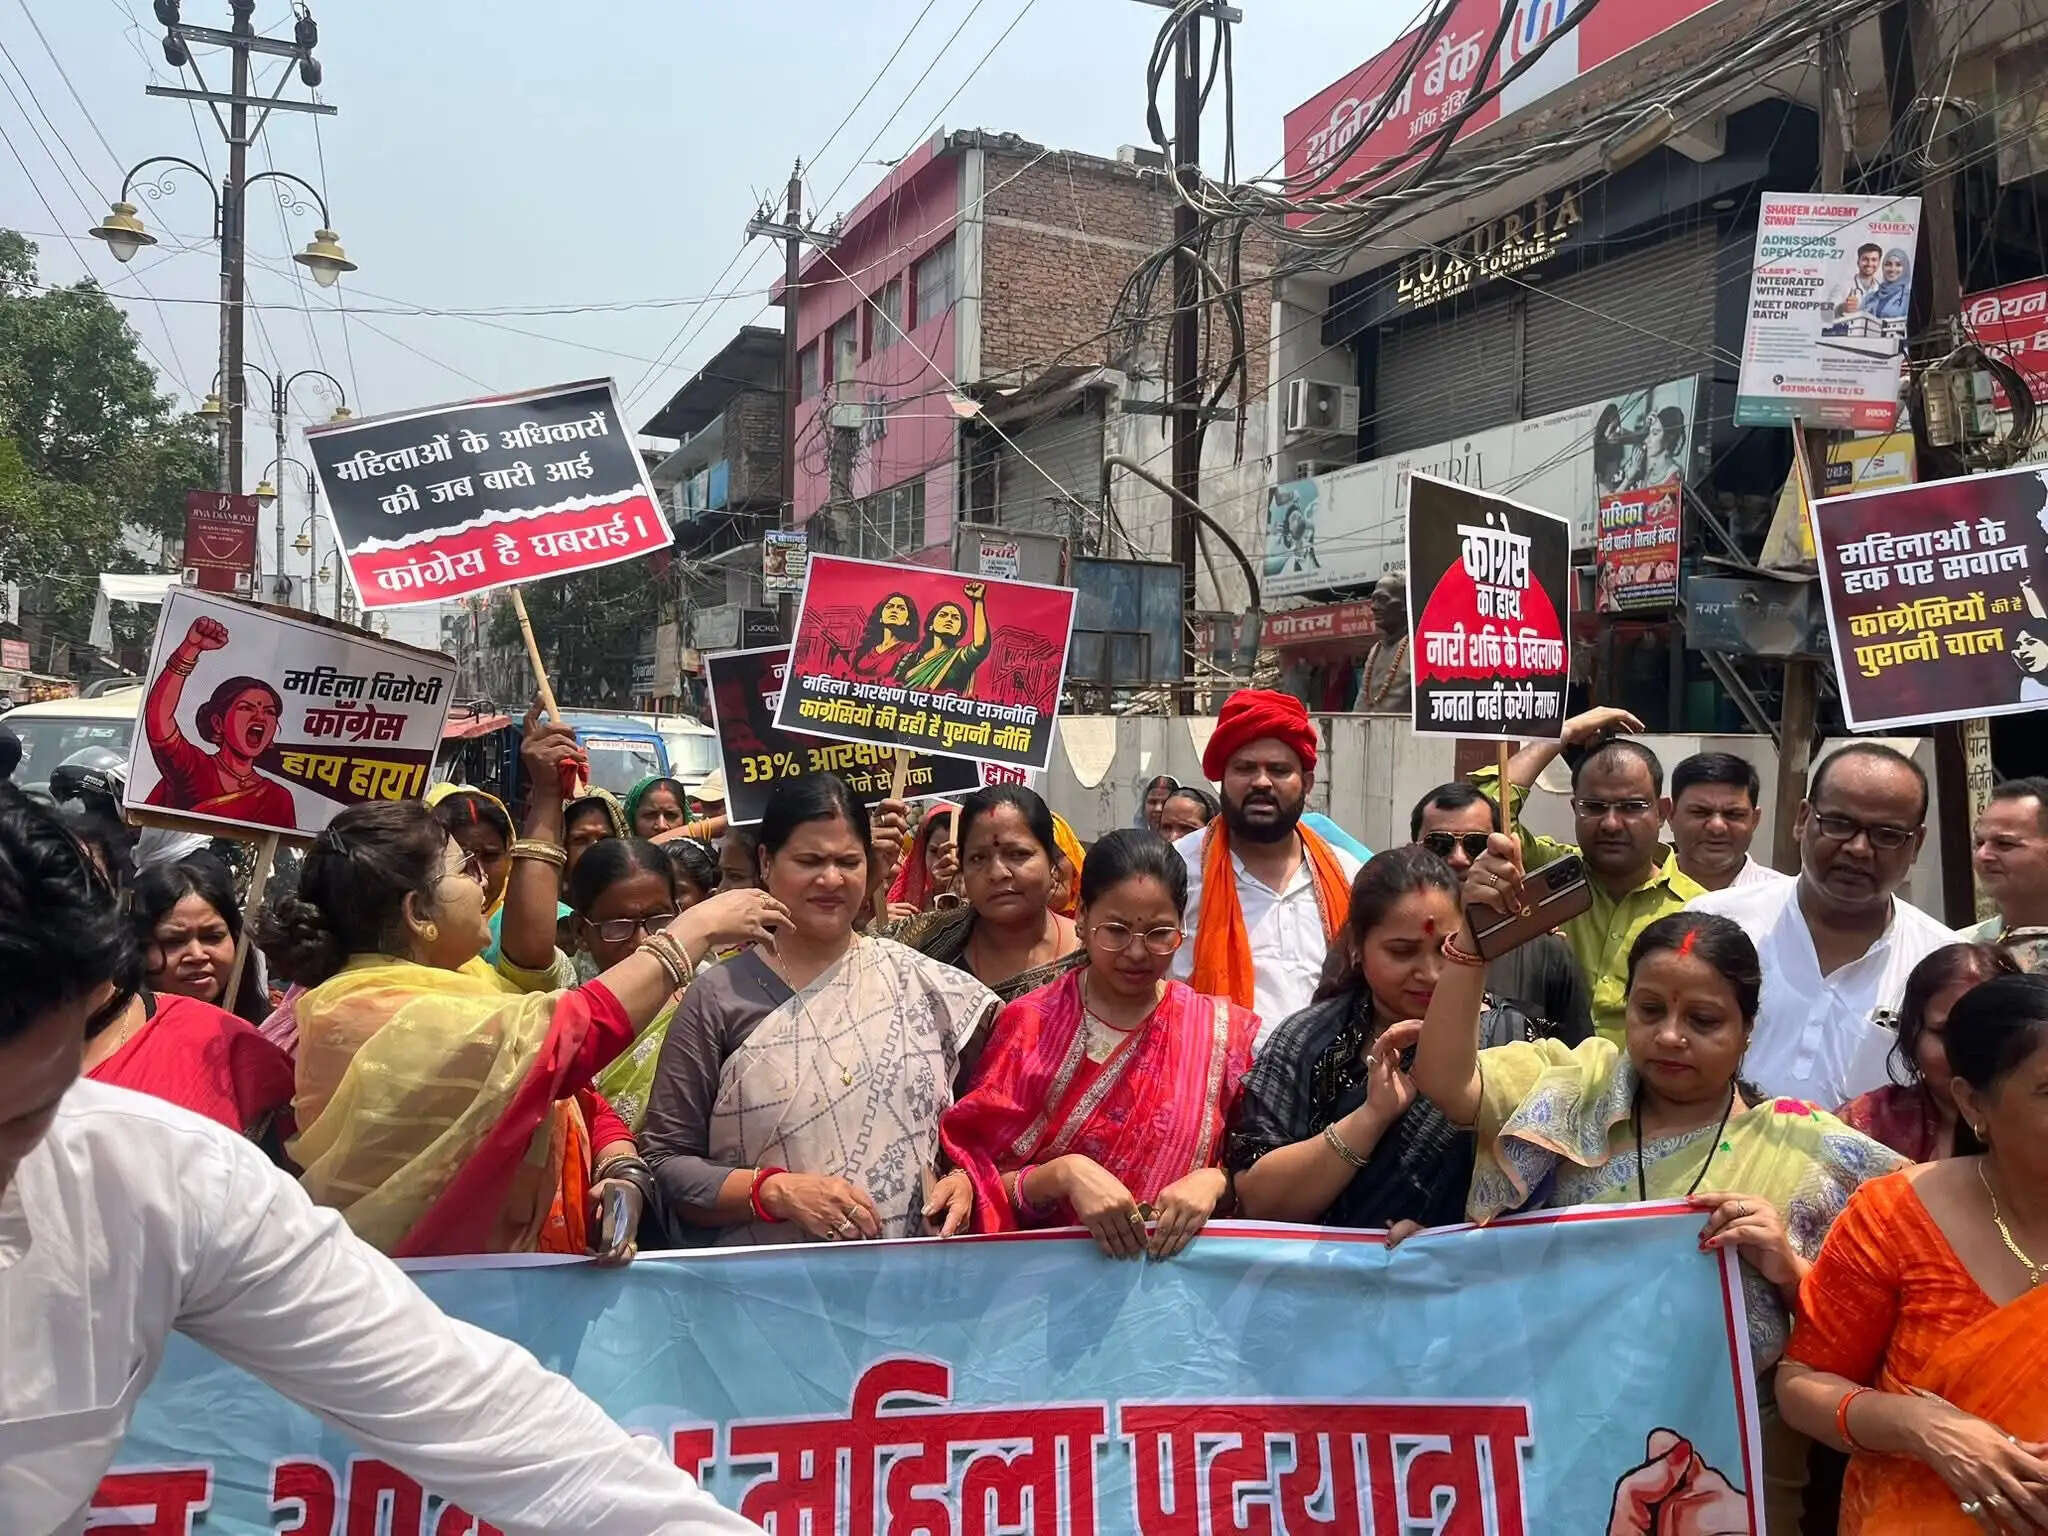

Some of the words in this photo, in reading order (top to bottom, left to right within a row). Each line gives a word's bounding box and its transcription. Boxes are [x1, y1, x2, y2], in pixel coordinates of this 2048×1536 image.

[1764, 216, 1796, 226] SIWAN
[1765, 204, 1810, 216] SHAHEEN
[1812, 207, 1859, 218] ACADEMY
[1868, 221, 1915, 232] SHAHEEN
[1760, 247, 1794, 258] OPEN
[1762, 235, 1837, 247] ADMISSIONS
[1413, 261, 1473, 301] BEAUTY
[1480, 240, 1547, 277] LOUNGE
[1756, 277, 1825, 287] INTEGRATED
[1753, 300, 1782, 310] NEET
[1783, 301, 1835, 312] DROPPER
[1756, 287, 1786, 296] WITH
[1786, 288, 1815, 297] NEET
[1752, 310, 1789, 320] BATCH
[331, 434, 453, 482] महिलाओं
[457, 429, 489, 454] के
[499, 411, 609, 449] अधिकारों
[378, 485, 420, 516] की
[427, 476, 475, 504] जब
[480, 461, 536, 491] बारी
[546, 451, 595, 482] आई
[212, 510, 256, 523] DIAMOND
[1975, 517, 2006, 547] के
[372, 552, 486, 592] कांग्रेस
[493, 532, 520, 567] है
[528, 512, 630, 558] घबराई
[1457, 512, 1532, 588] कांग्रेस
[1841, 566, 1891, 594] हक
[1893, 559, 1934, 586] पर
[1939, 544, 2029, 580] सवाल
[1475, 583, 1495, 617] का
[1848, 591, 1986, 637] कांग्रेसियों
[1991, 599, 2009, 614] की
[1424, 621, 1466, 668] नारी
[1468, 623, 1502, 668] शक्ति
[1502, 625, 1518, 669] के
[1518, 627, 1564, 671] खिलाफ
[1853, 630, 1940, 678] पुरानी
[1944, 627, 2005, 656] चाल
[283, 665, 368, 701] महिला
[369, 671, 444, 705] विरोधी
[802, 674, 850, 696] महिला
[851, 682, 906, 704] आरक्षण
[908, 691, 931, 708] पर
[931, 692, 974, 715] घटिया
[976, 698, 1039, 727] राजनीति
[1429, 689, 1474, 722] जनता
[1475, 680, 1503, 721] नहीं
[1502, 681, 1534, 720] करेगी
[799, 697, 875, 727] कांग्रेसियों
[875, 704, 898, 729] की
[899, 711, 926, 735] रही
[941, 718, 993, 747] पुरानी
[993, 722, 1033, 753] नीति
[1968, 737, 1989, 758] पान
[280, 751, 348, 788] हाय
[740, 752, 801, 783] 33%
[875, 767, 891, 791] से
[727, 1355, 1108, 1536] महिला
